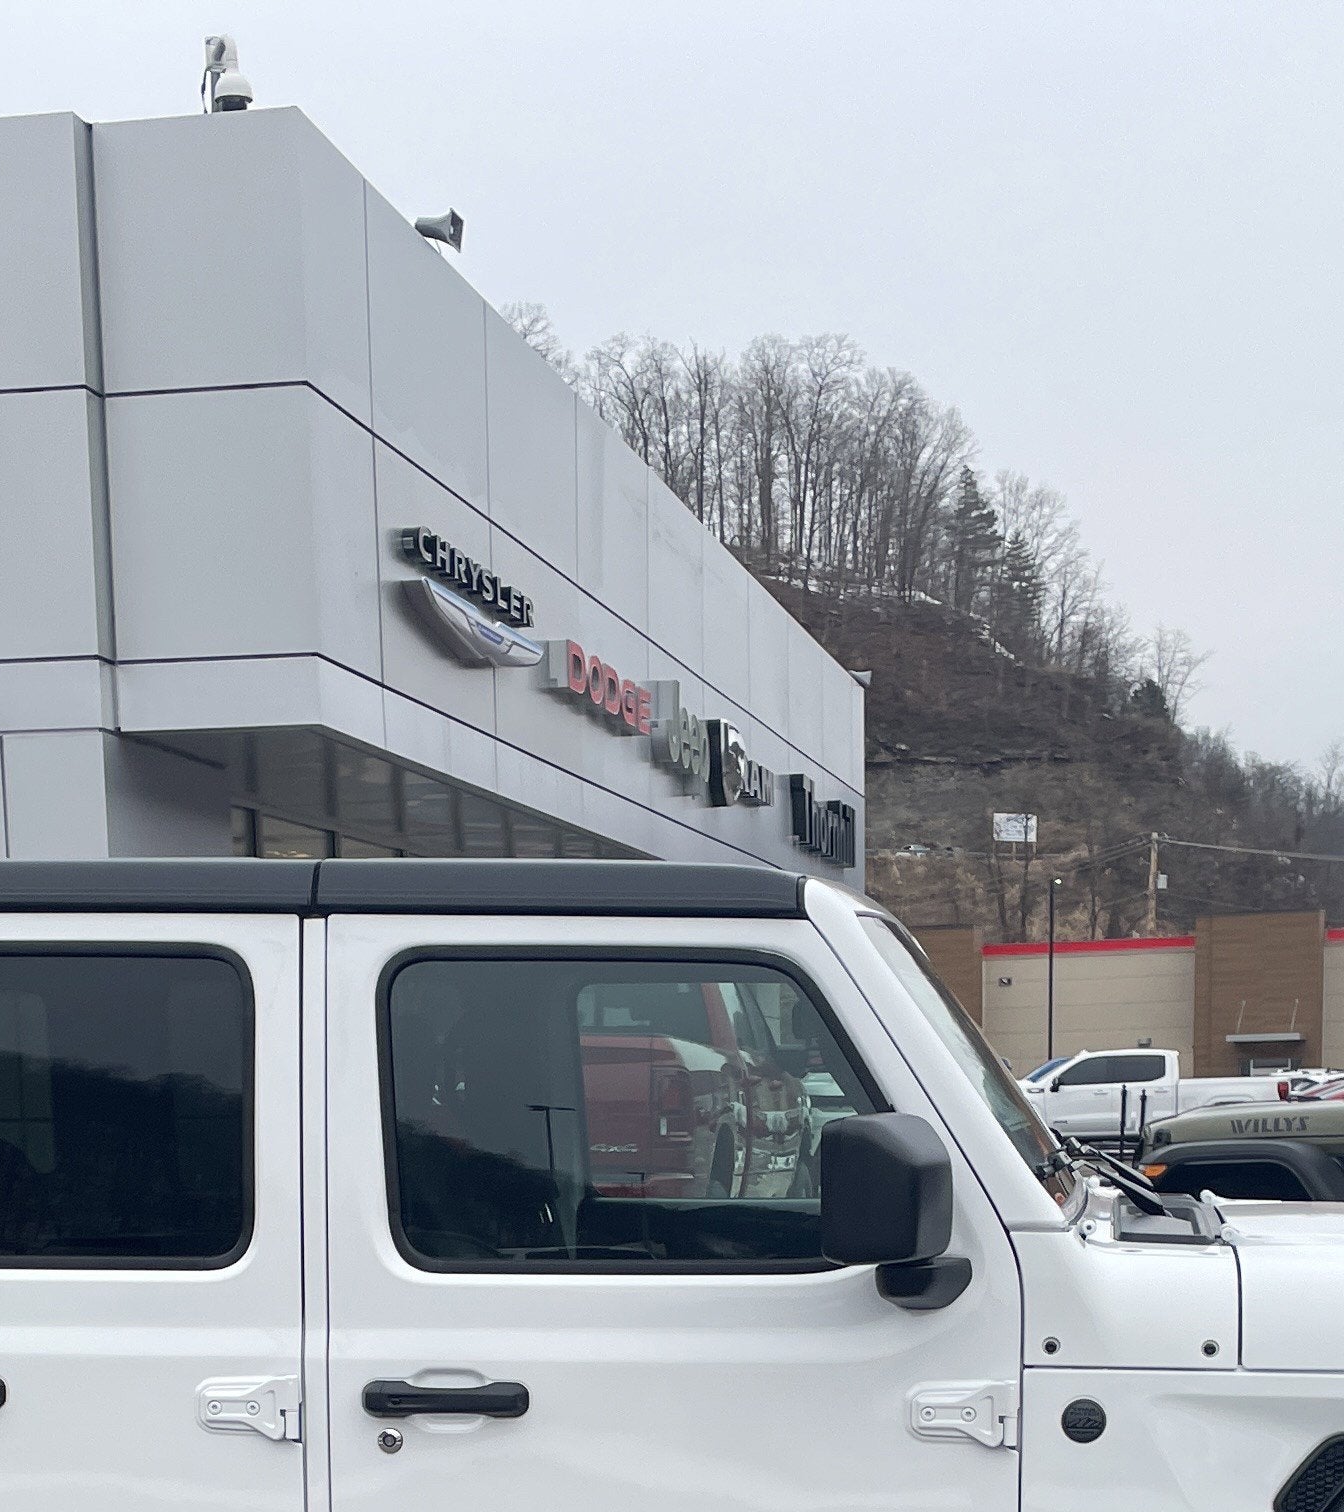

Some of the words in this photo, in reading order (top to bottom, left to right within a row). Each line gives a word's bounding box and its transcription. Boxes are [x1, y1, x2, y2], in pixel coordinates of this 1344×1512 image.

[409, 526, 534, 628] CHRYSLER
[567, 639, 652, 736] DODGE
[1231, 1116, 1309, 1134] WILLYS
